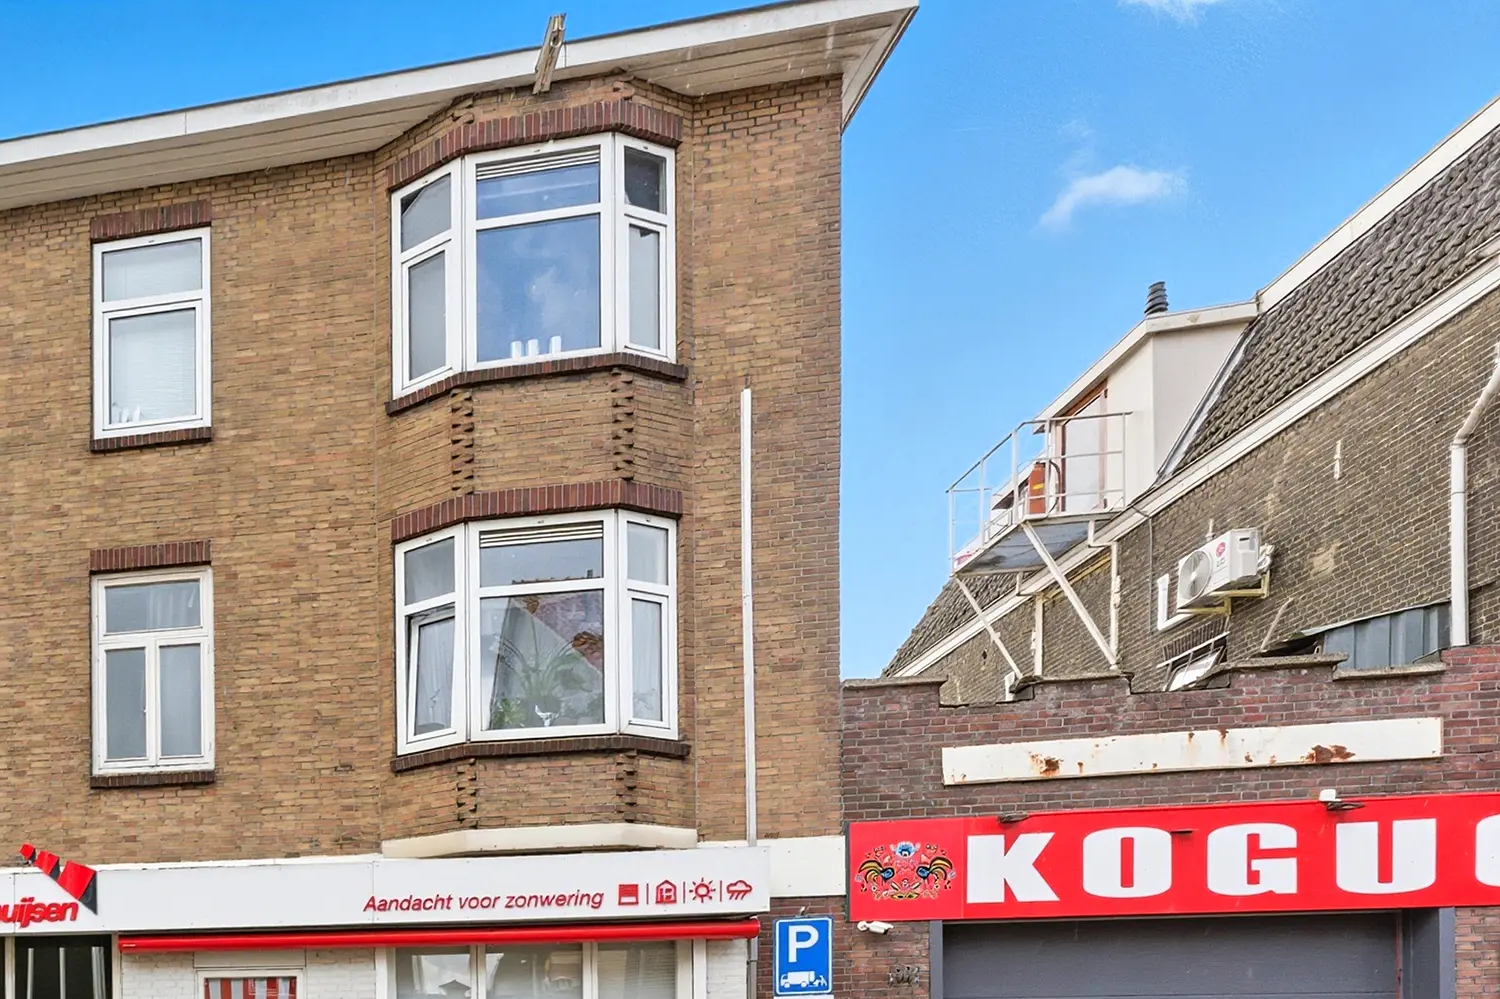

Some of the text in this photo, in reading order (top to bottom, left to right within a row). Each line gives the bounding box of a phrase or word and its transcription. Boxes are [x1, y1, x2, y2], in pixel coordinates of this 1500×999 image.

[363, 889, 605, 912] Aandacht voor zonwering
[788, 924, 819, 963] P
